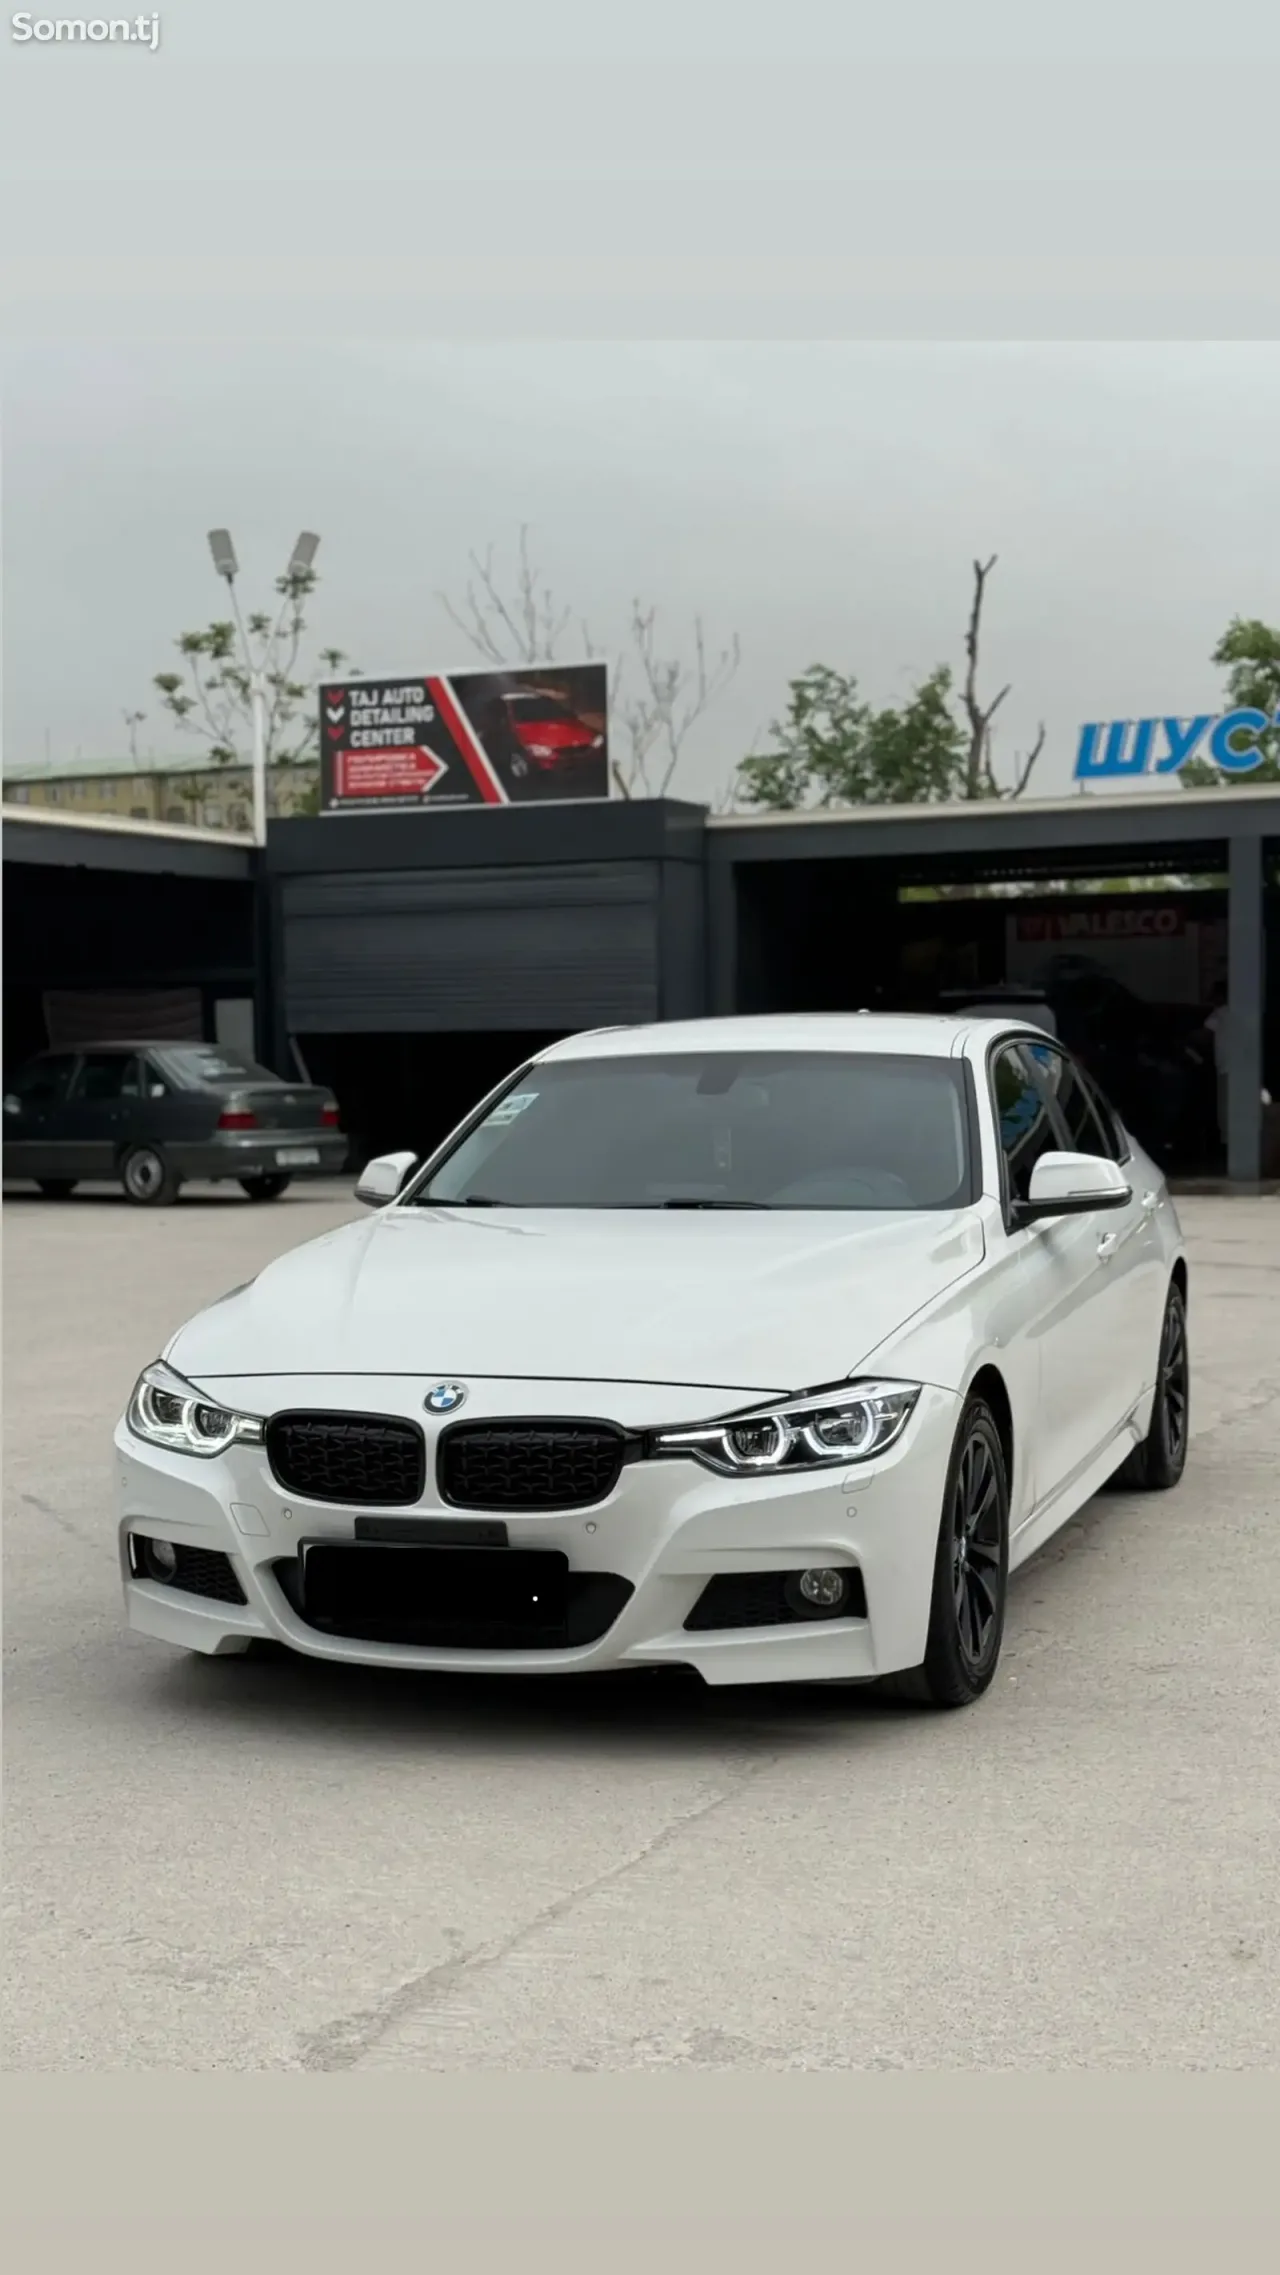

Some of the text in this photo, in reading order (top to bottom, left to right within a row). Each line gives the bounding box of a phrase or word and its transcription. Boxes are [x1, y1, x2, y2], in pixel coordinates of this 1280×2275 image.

[349, 686, 424, 707] TAJ AUTO
[350, 705, 434, 727] DETAILING
[350, 727, 415, 747] CENTER
[1074, 705, 1280, 780] ШУС
